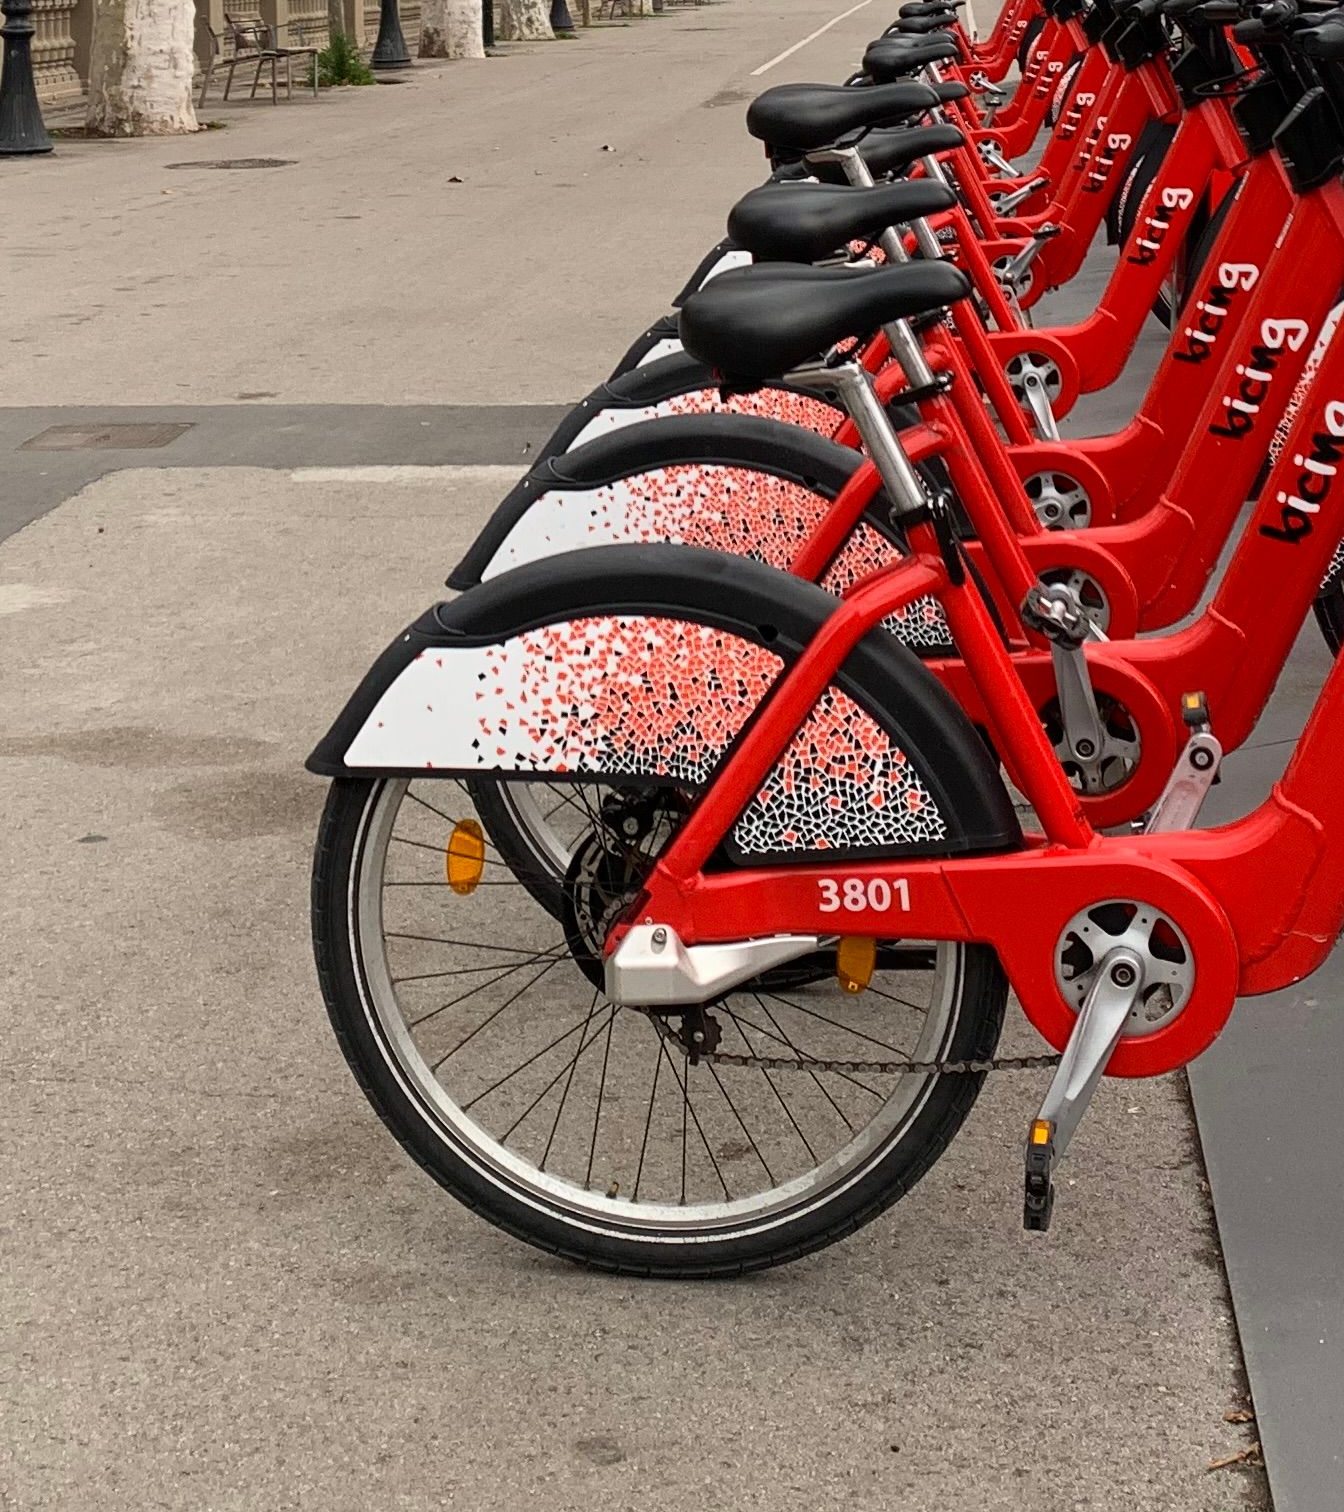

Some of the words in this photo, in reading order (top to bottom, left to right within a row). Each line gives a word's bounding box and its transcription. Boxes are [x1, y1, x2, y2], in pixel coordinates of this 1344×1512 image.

[1081, 133, 1131, 192] bicing
[1128, 187, 1194, 266] bicing
[1174, 262, 1259, 365] bicing
[1209, 318, 1310, 440] bicing
[818, 878, 911, 913] 3801
